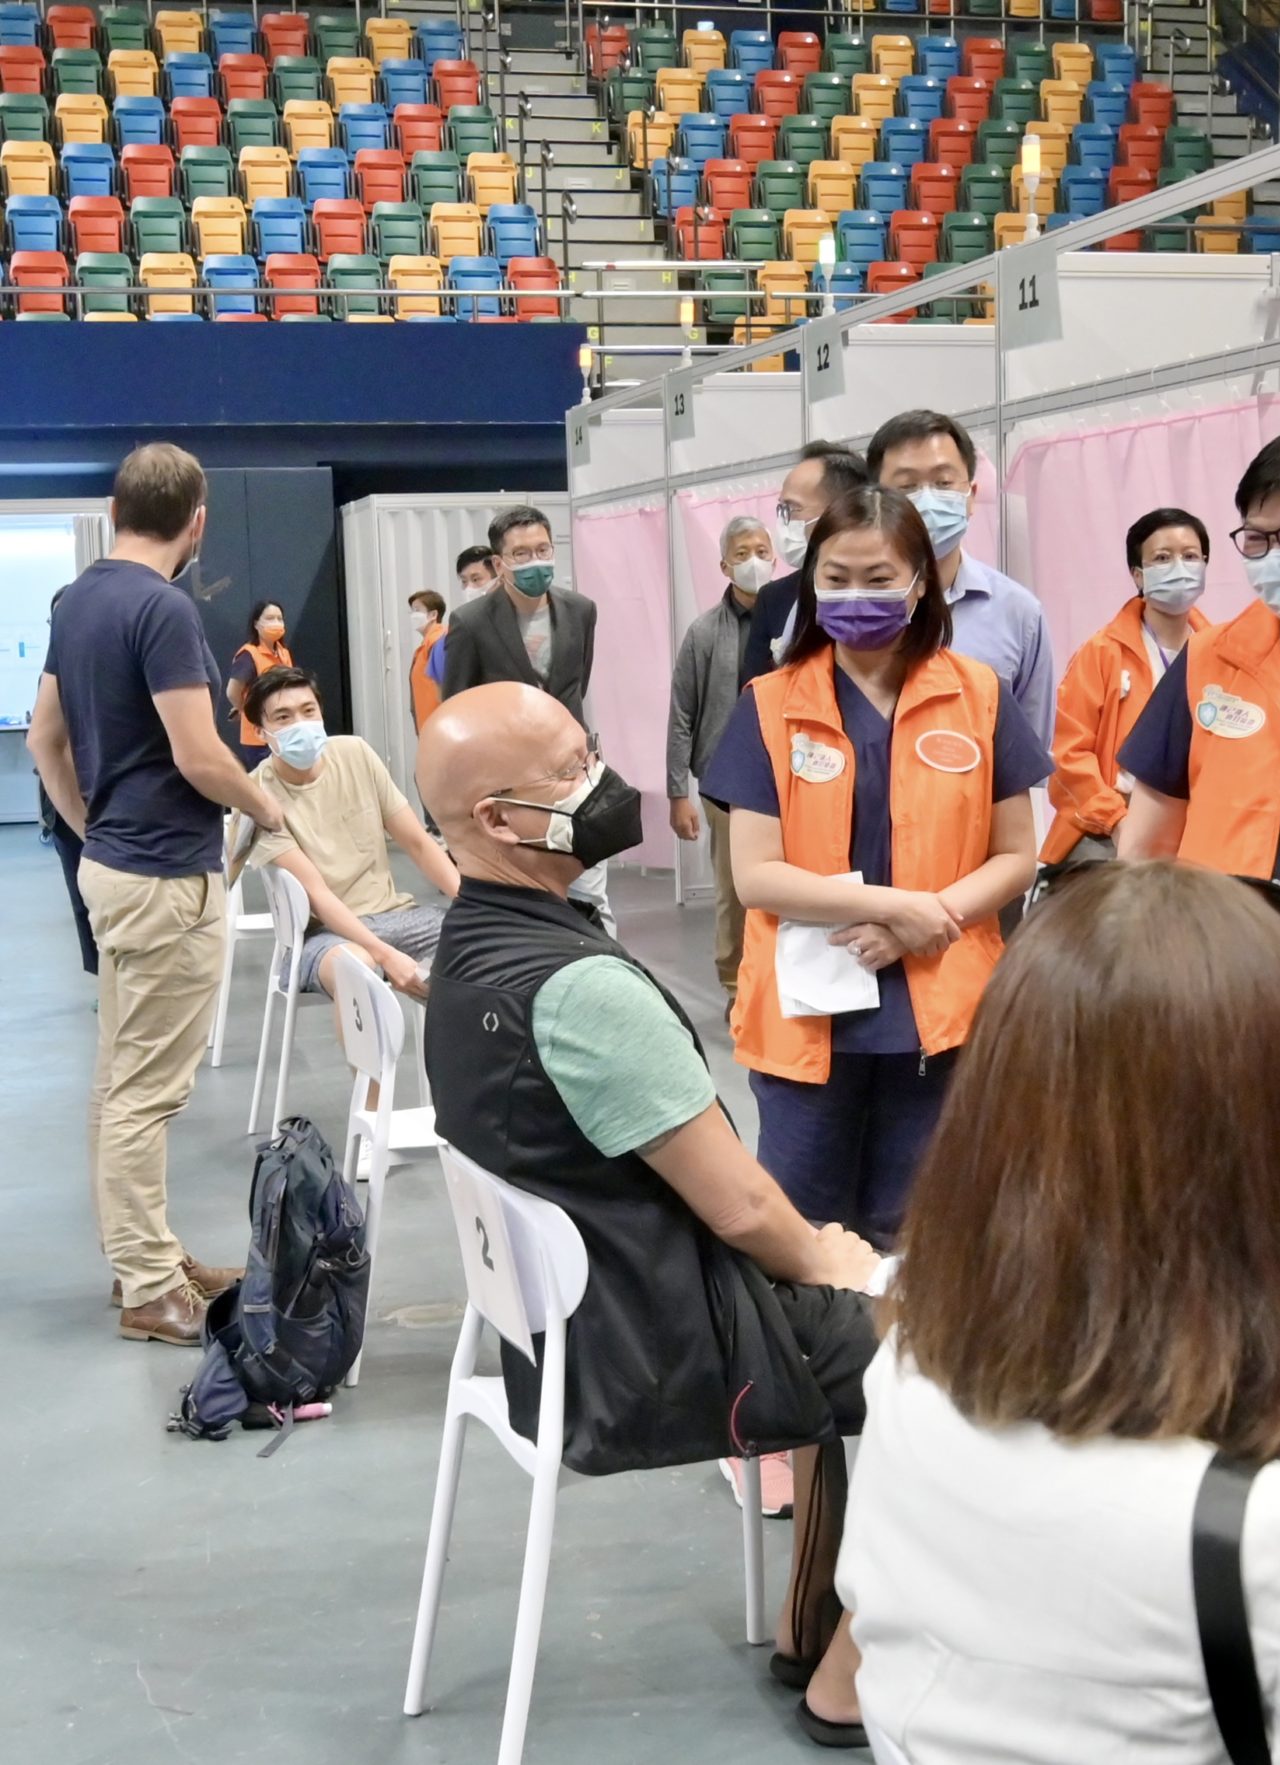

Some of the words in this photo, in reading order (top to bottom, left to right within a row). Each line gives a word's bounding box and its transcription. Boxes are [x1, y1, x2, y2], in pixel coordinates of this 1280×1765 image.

[505, 118, 514, 130] K
[592, 122, 601, 134] K
[526, 166, 534, 178] J
[615, 168, 623, 180] J
[662, 271, 672, 284] H
[1018, 273, 1040, 312] 11
[588, 327, 599, 340] G
[688, 328, 699, 340] G
[604, 355, 613, 368] F
[816, 342, 830, 373] 12
[674, 392, 685, 417] 13
[575, 425, 583, 446] 14
[352, 997, 363, 1033] 3
[475, 1215, 495, 1273] 2
